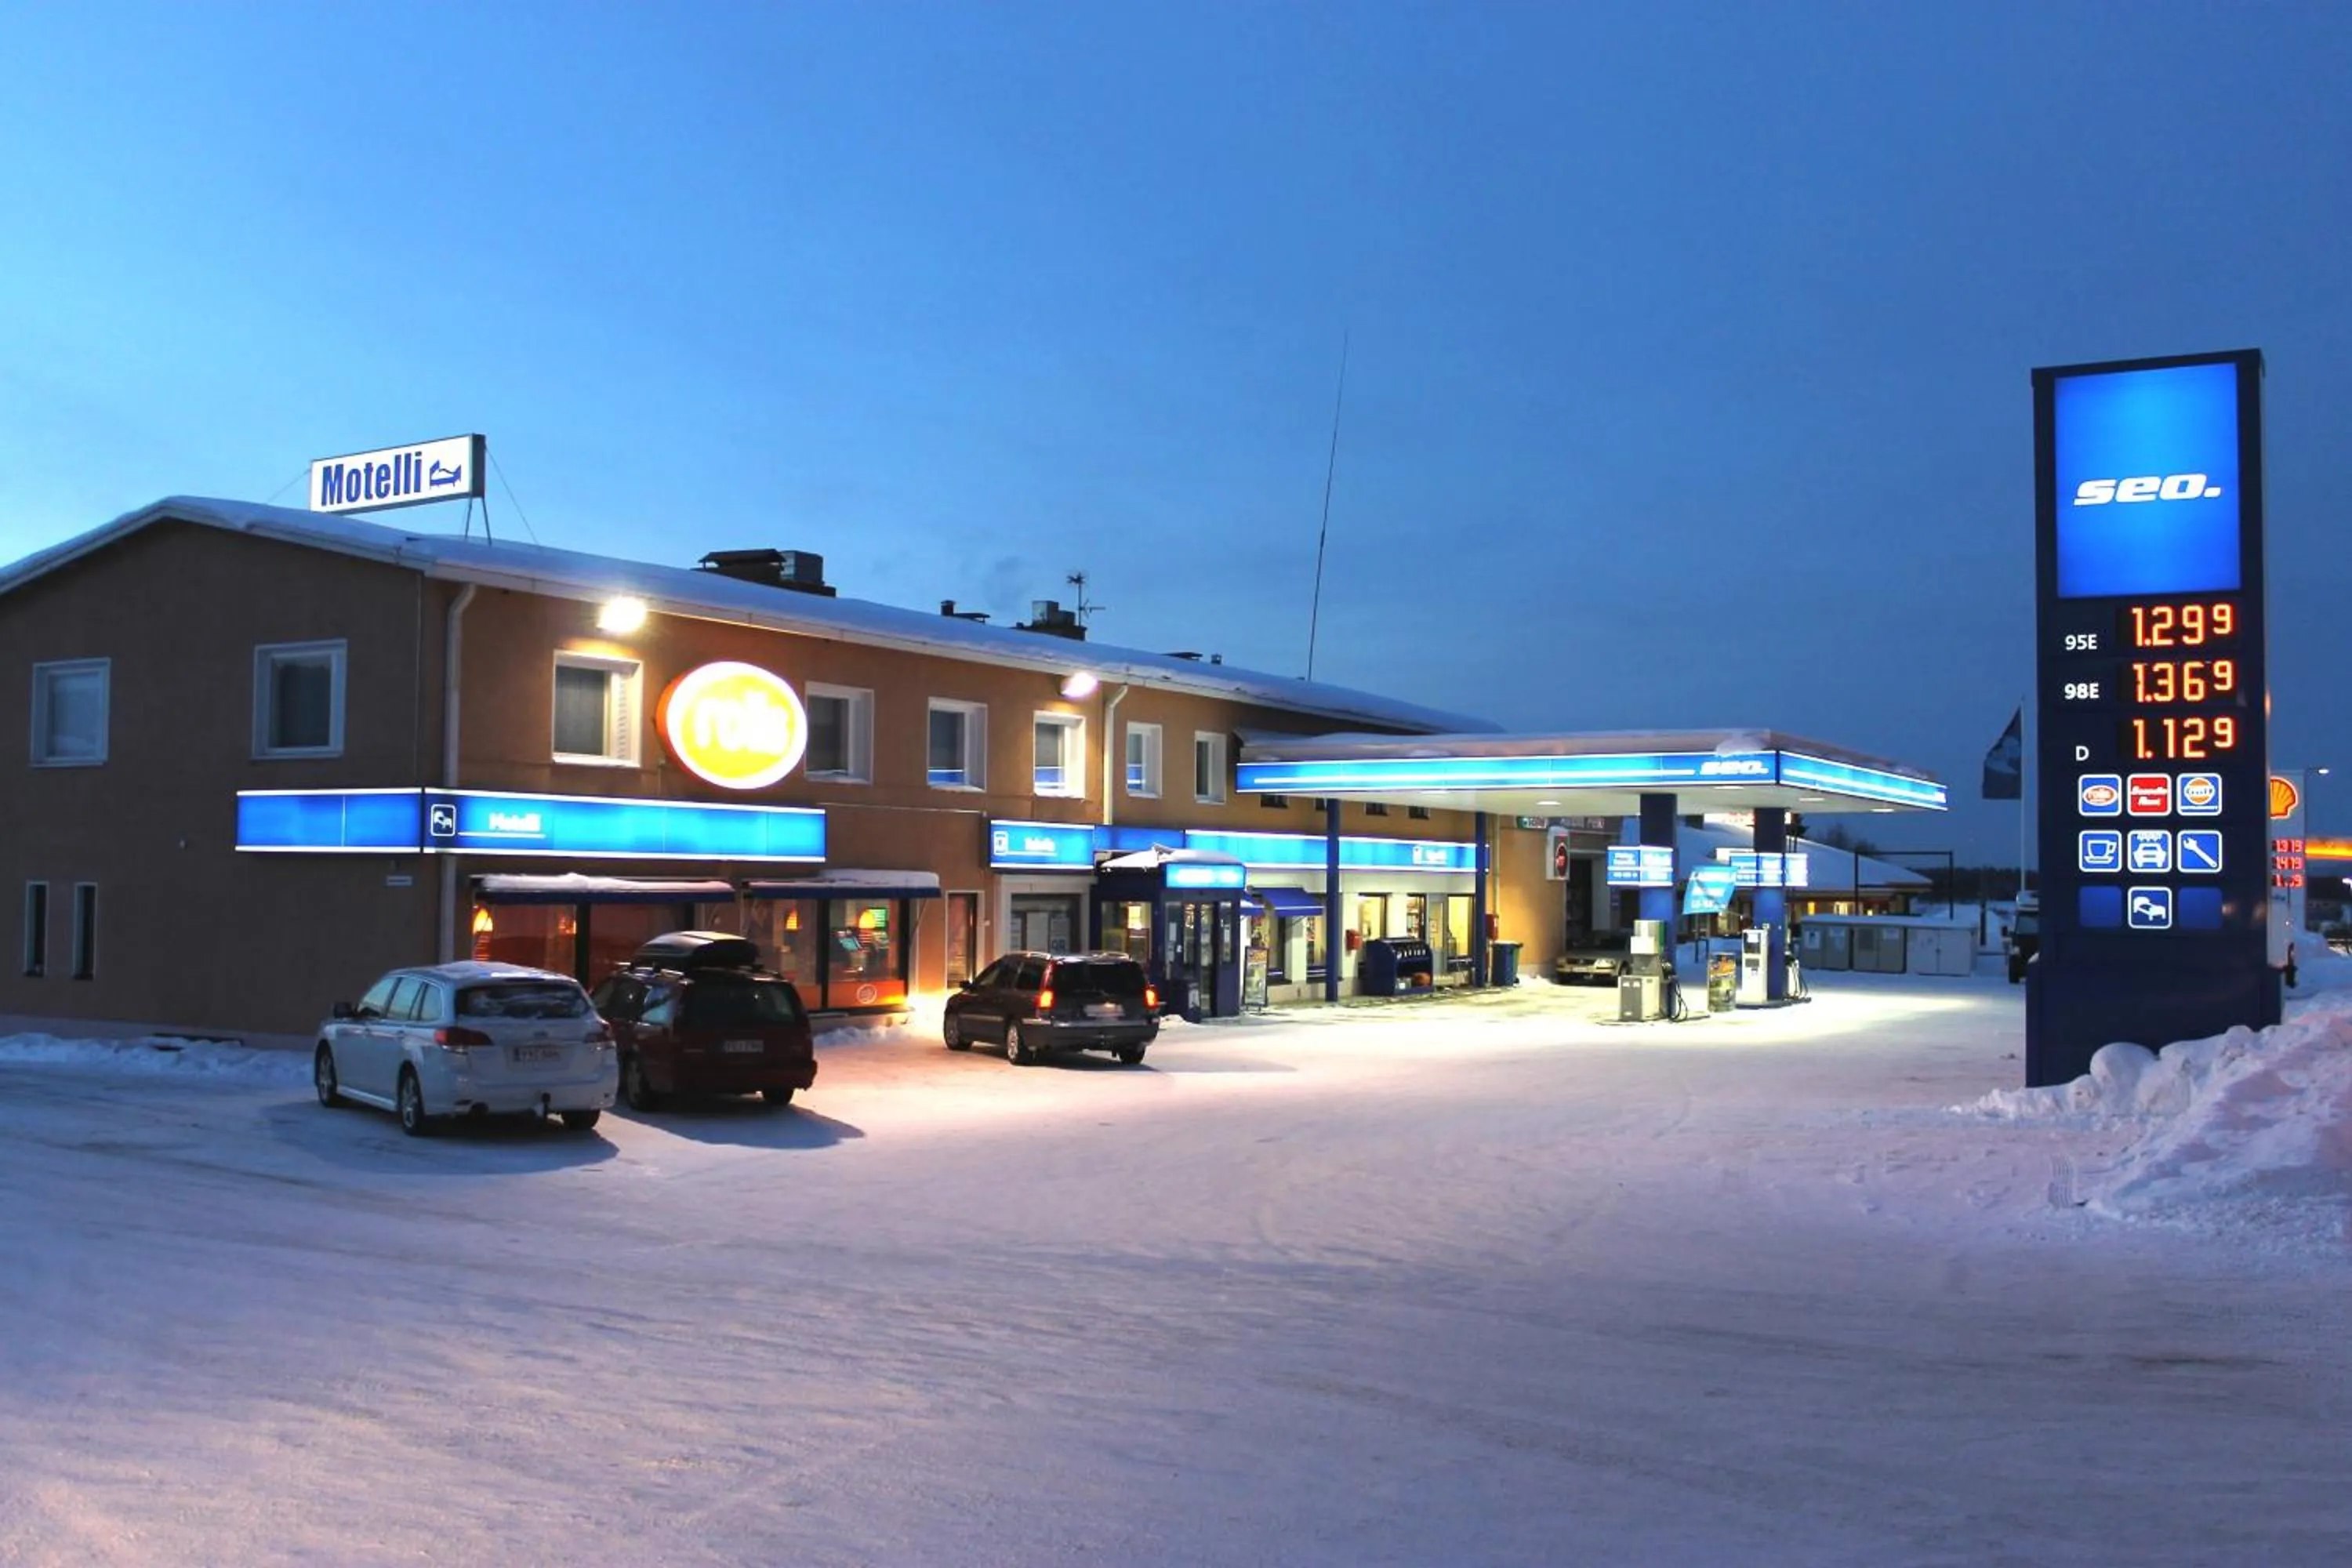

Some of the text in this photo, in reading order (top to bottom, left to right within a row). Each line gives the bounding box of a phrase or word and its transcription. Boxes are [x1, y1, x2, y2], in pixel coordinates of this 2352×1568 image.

[321, 452, 423, 506] Motelli
[2074, 473, 2221, 506] seo.
[2064, 604, 2233, 651] 95E 1.299
[2064, 660, 2233, 702] 98E 1.369
[2075, 717, 2234, 761] D 1.129
